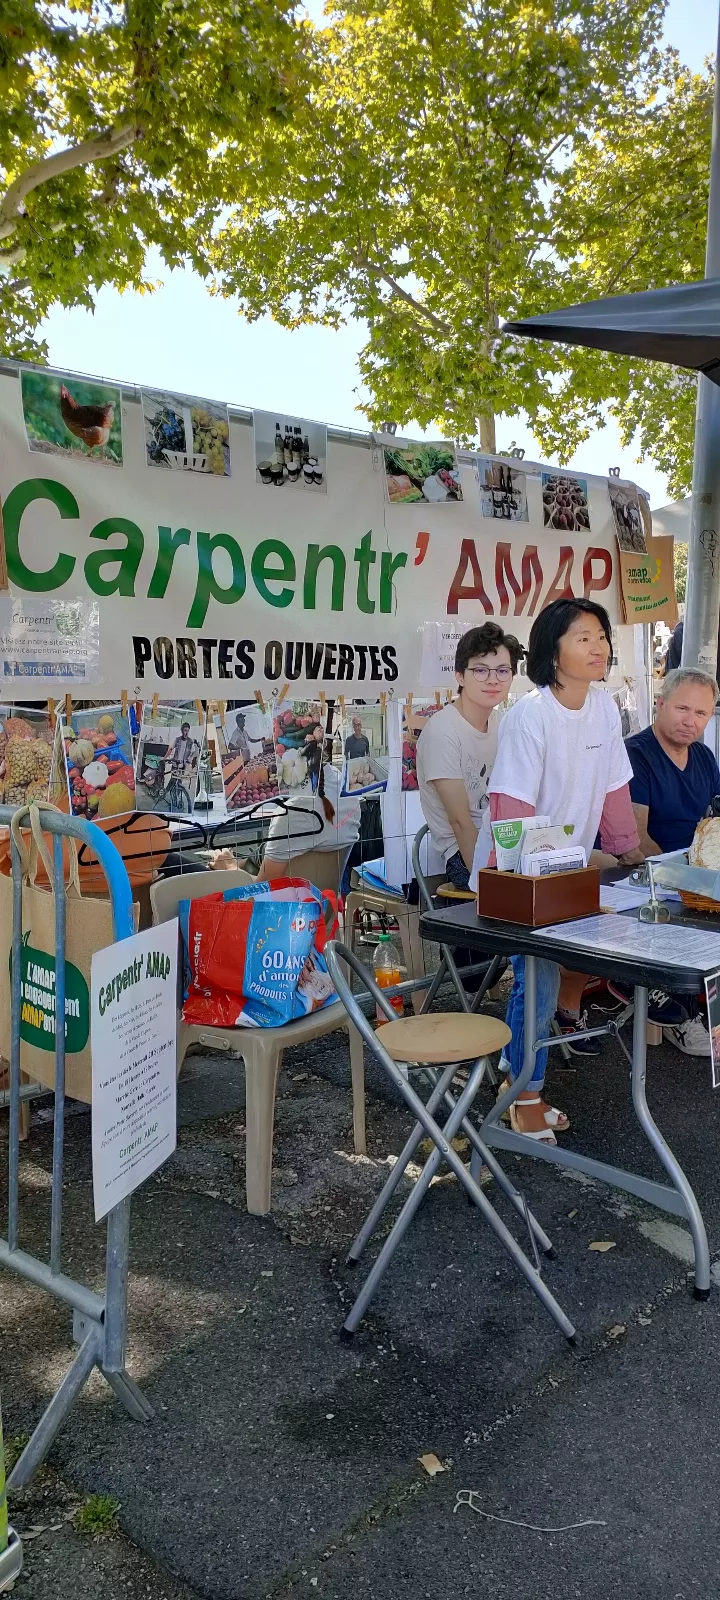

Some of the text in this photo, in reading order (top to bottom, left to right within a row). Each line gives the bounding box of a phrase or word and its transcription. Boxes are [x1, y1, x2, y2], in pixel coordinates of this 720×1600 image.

[447, 539, 612, 617] AMAP
[132, 636, 399, 682] PORTES OUVERTES
[146, 951, 170, 981] AMAP
[262, 950, 306, 970] 60 ANS
[250, 981, 287, 1000] PRODUITS
